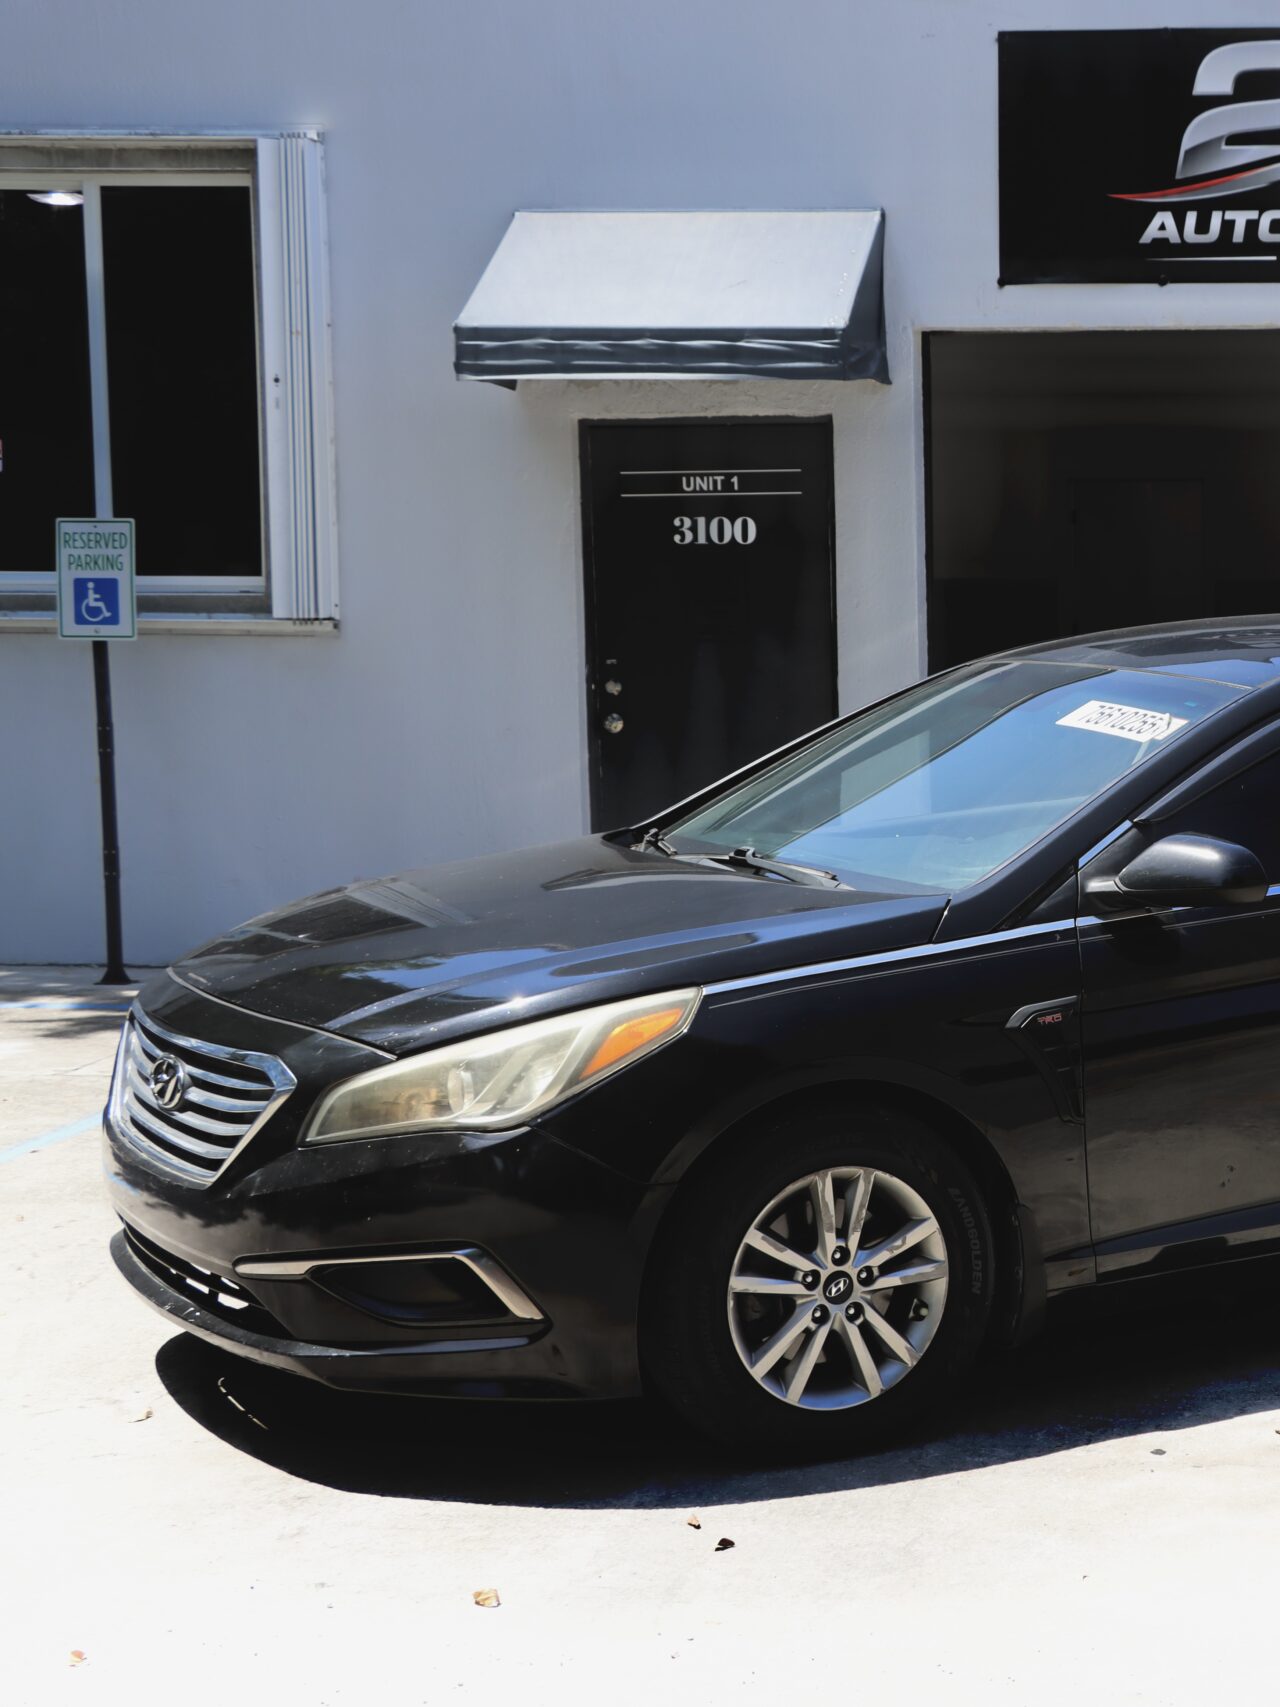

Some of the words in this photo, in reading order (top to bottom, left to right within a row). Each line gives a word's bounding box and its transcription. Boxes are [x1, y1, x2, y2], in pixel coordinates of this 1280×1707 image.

[682, 475, 725, 492] UNIT
[730, 475, 740, 491] 1
[673, 516, 757, 545] 3100
[63, 531, 128, 550] RESERVED
[67, 554, 124, 572] PARKING
